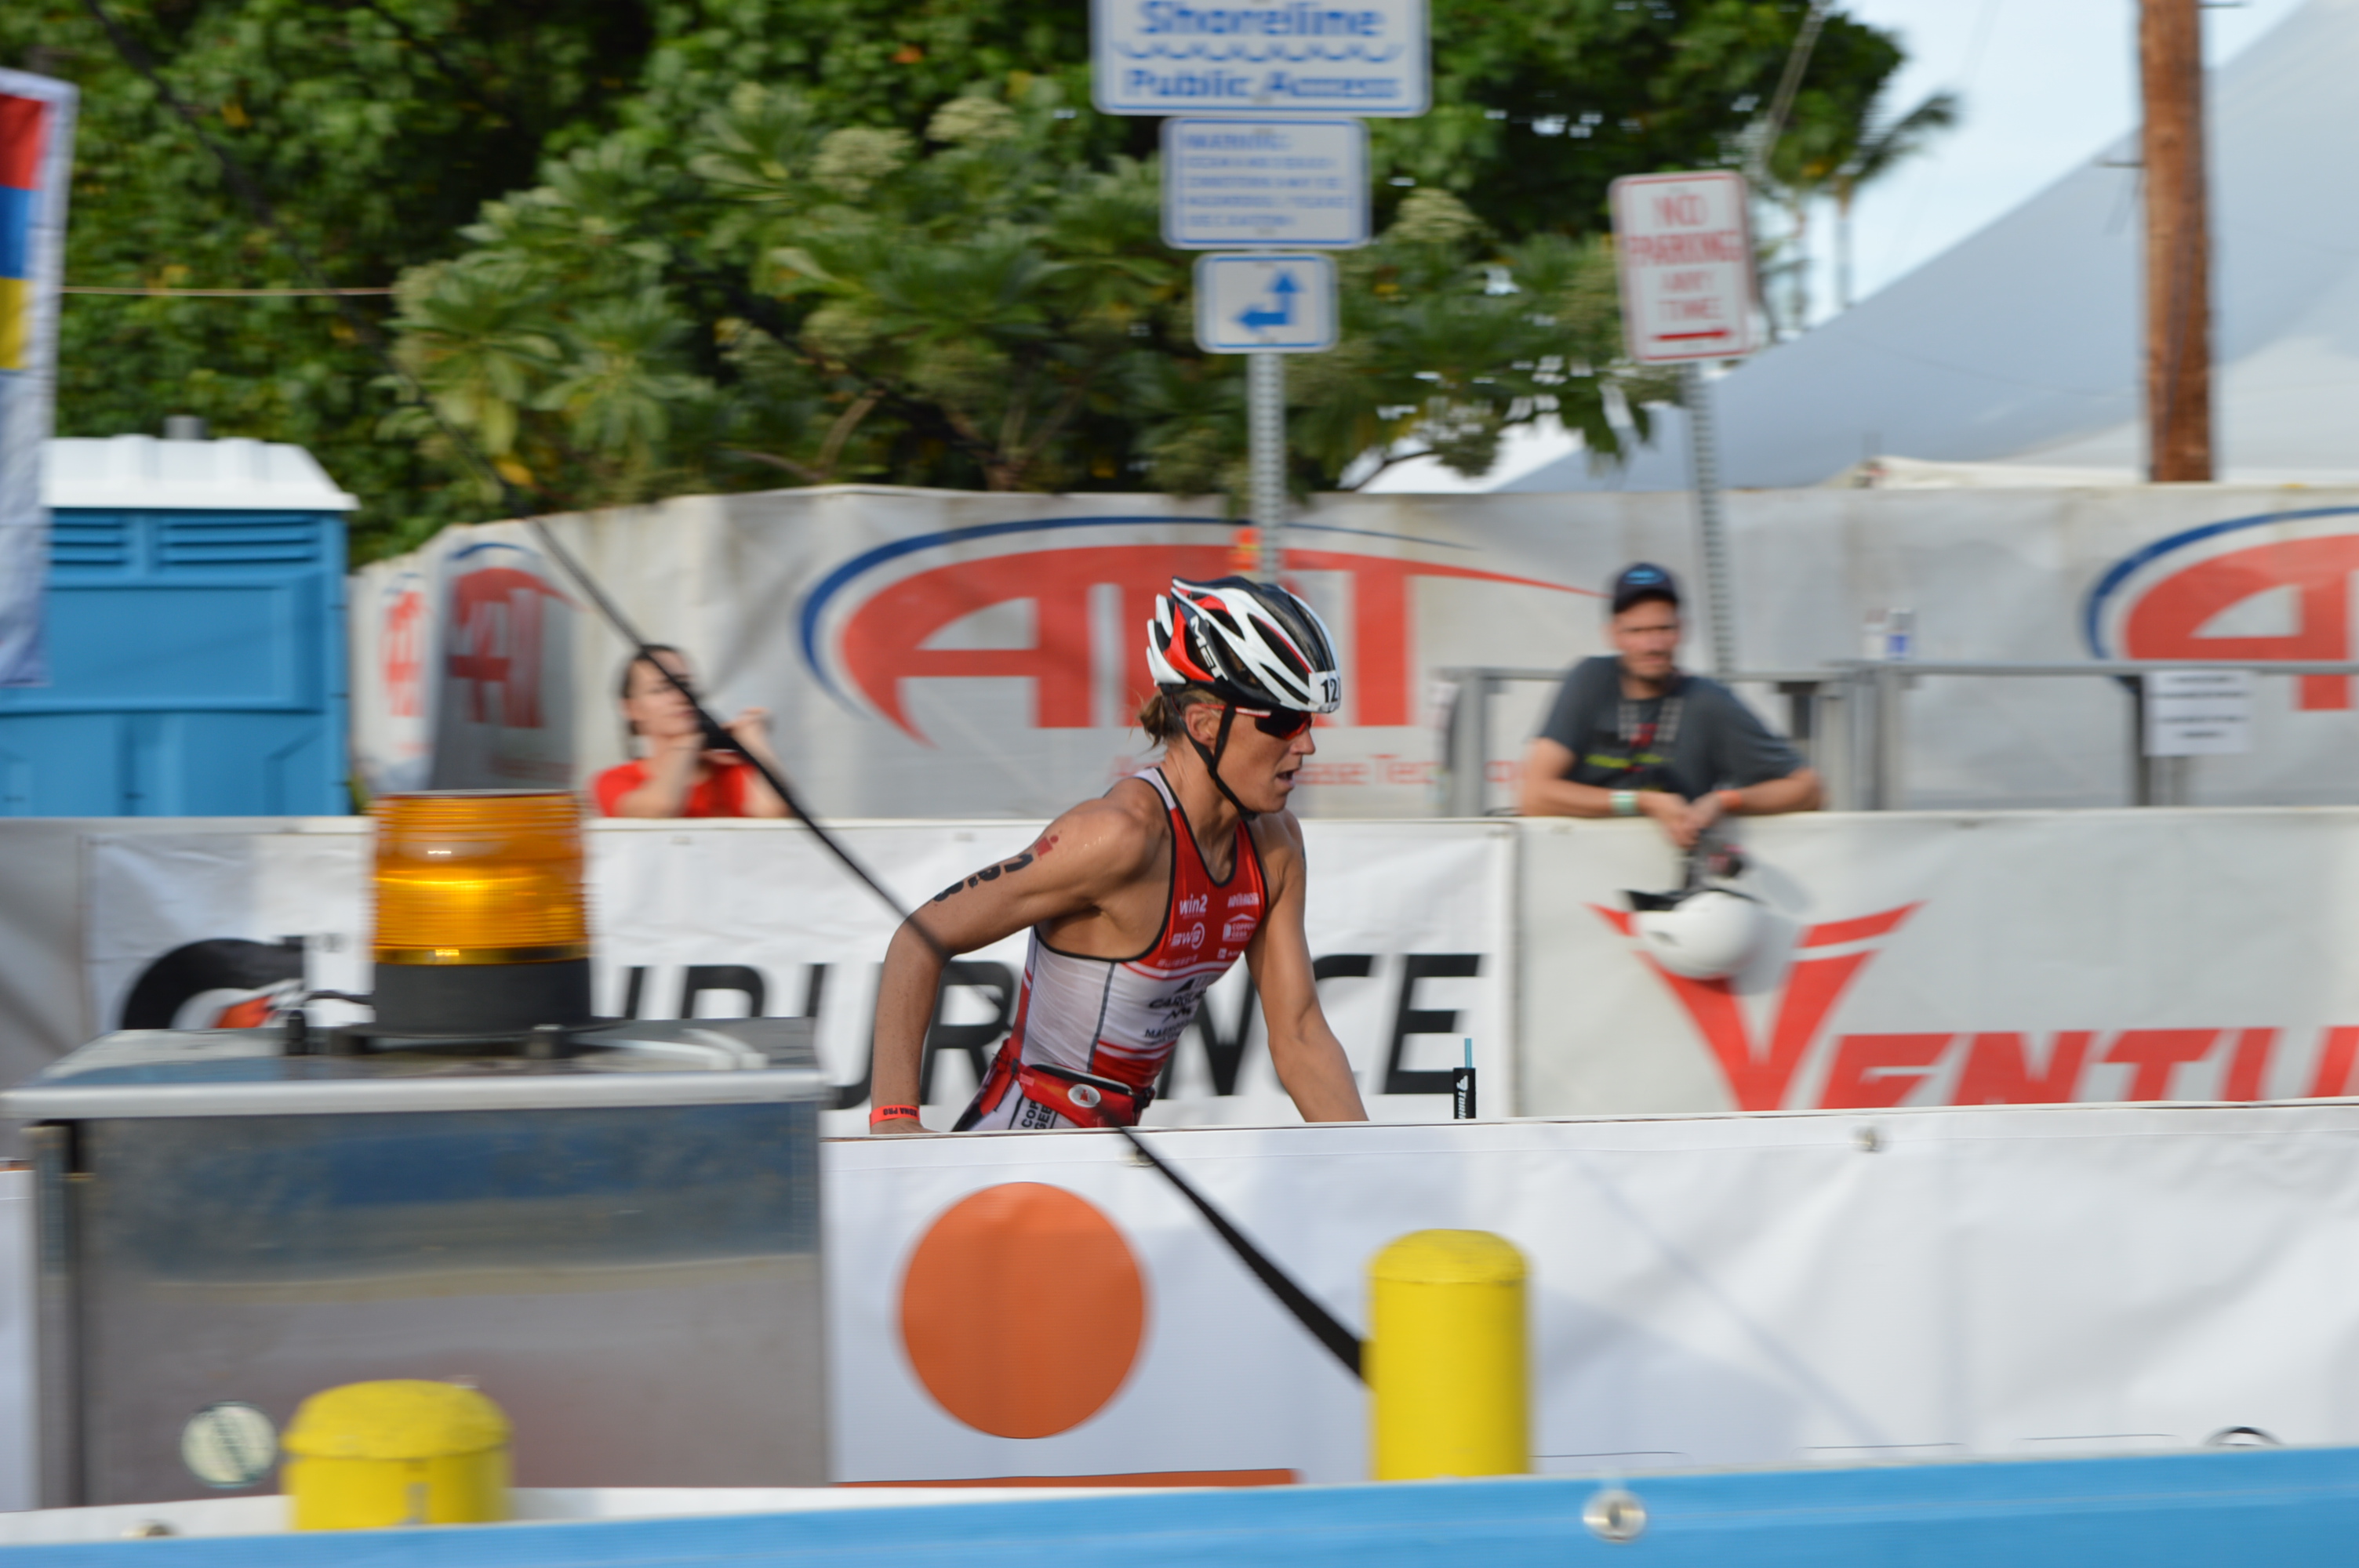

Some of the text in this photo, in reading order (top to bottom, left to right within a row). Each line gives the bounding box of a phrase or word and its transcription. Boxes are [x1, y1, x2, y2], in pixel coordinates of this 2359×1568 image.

[1138, 1, 1384, 37] Shoreline
[1124, 69, 1400, 99] Public Access
[1652, 194, 1710, 227] NO
[1626, 230, 1743, 268] PARKING
[1190, 615, 1230, 681] MET
[1180, 893, 1208, 916] win2
[883, 1107, 899, 1116] PRO
